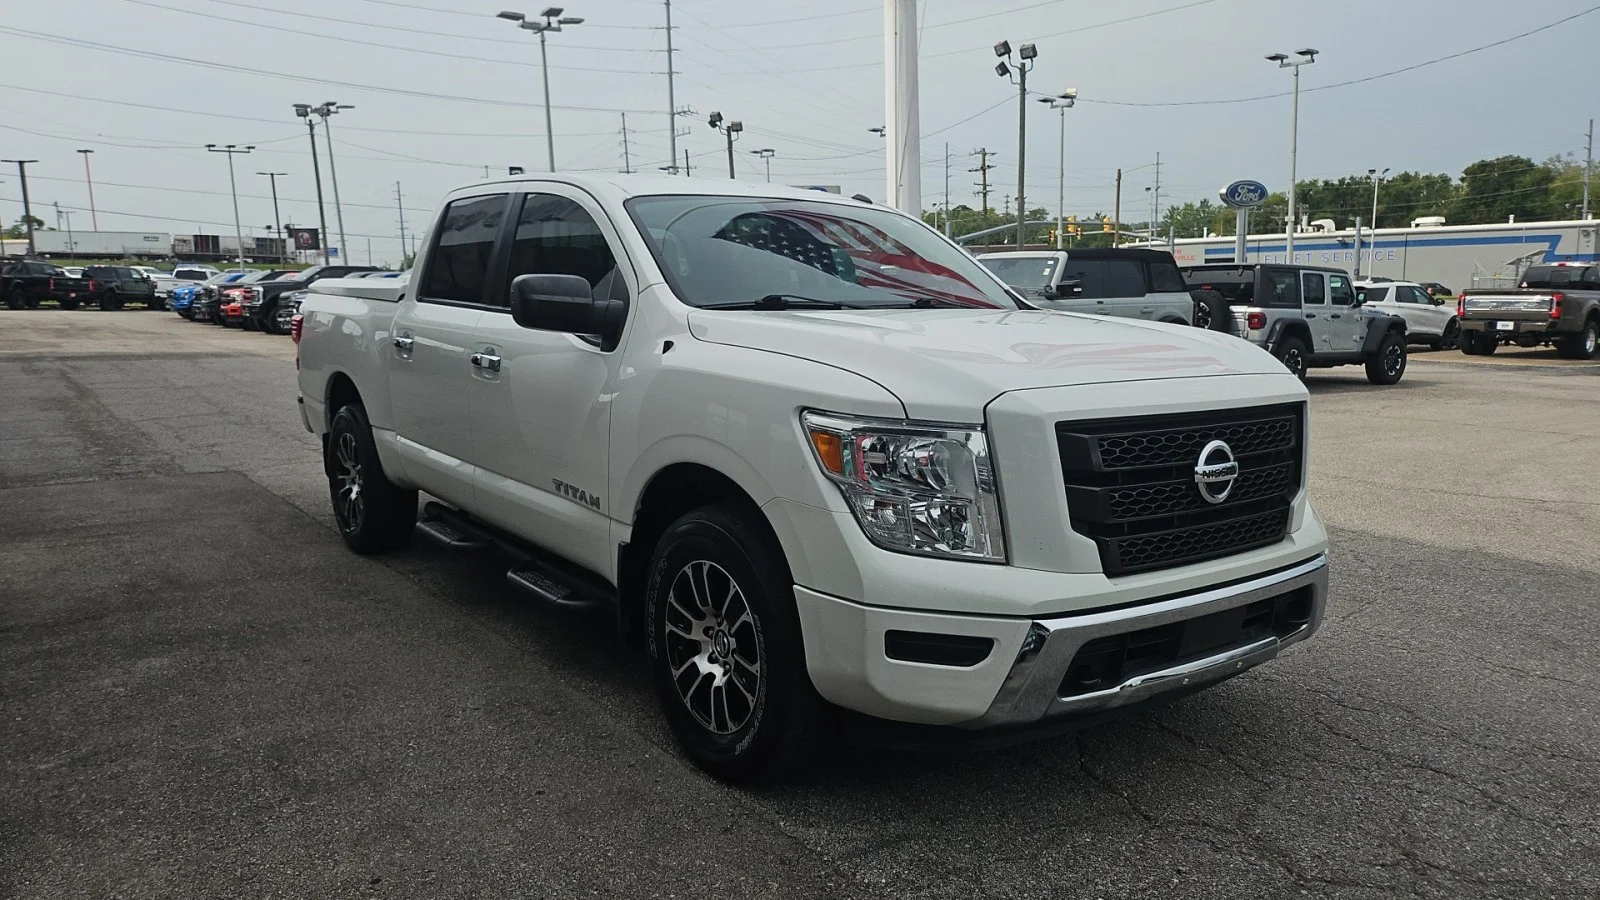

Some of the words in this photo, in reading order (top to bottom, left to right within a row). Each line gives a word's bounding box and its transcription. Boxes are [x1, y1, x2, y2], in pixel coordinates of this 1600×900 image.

[1235, 185, 1261, 201] Ford
[1321, 250, 1396, 263] SERVICE
[552, 478, 600, 510] TITAN
